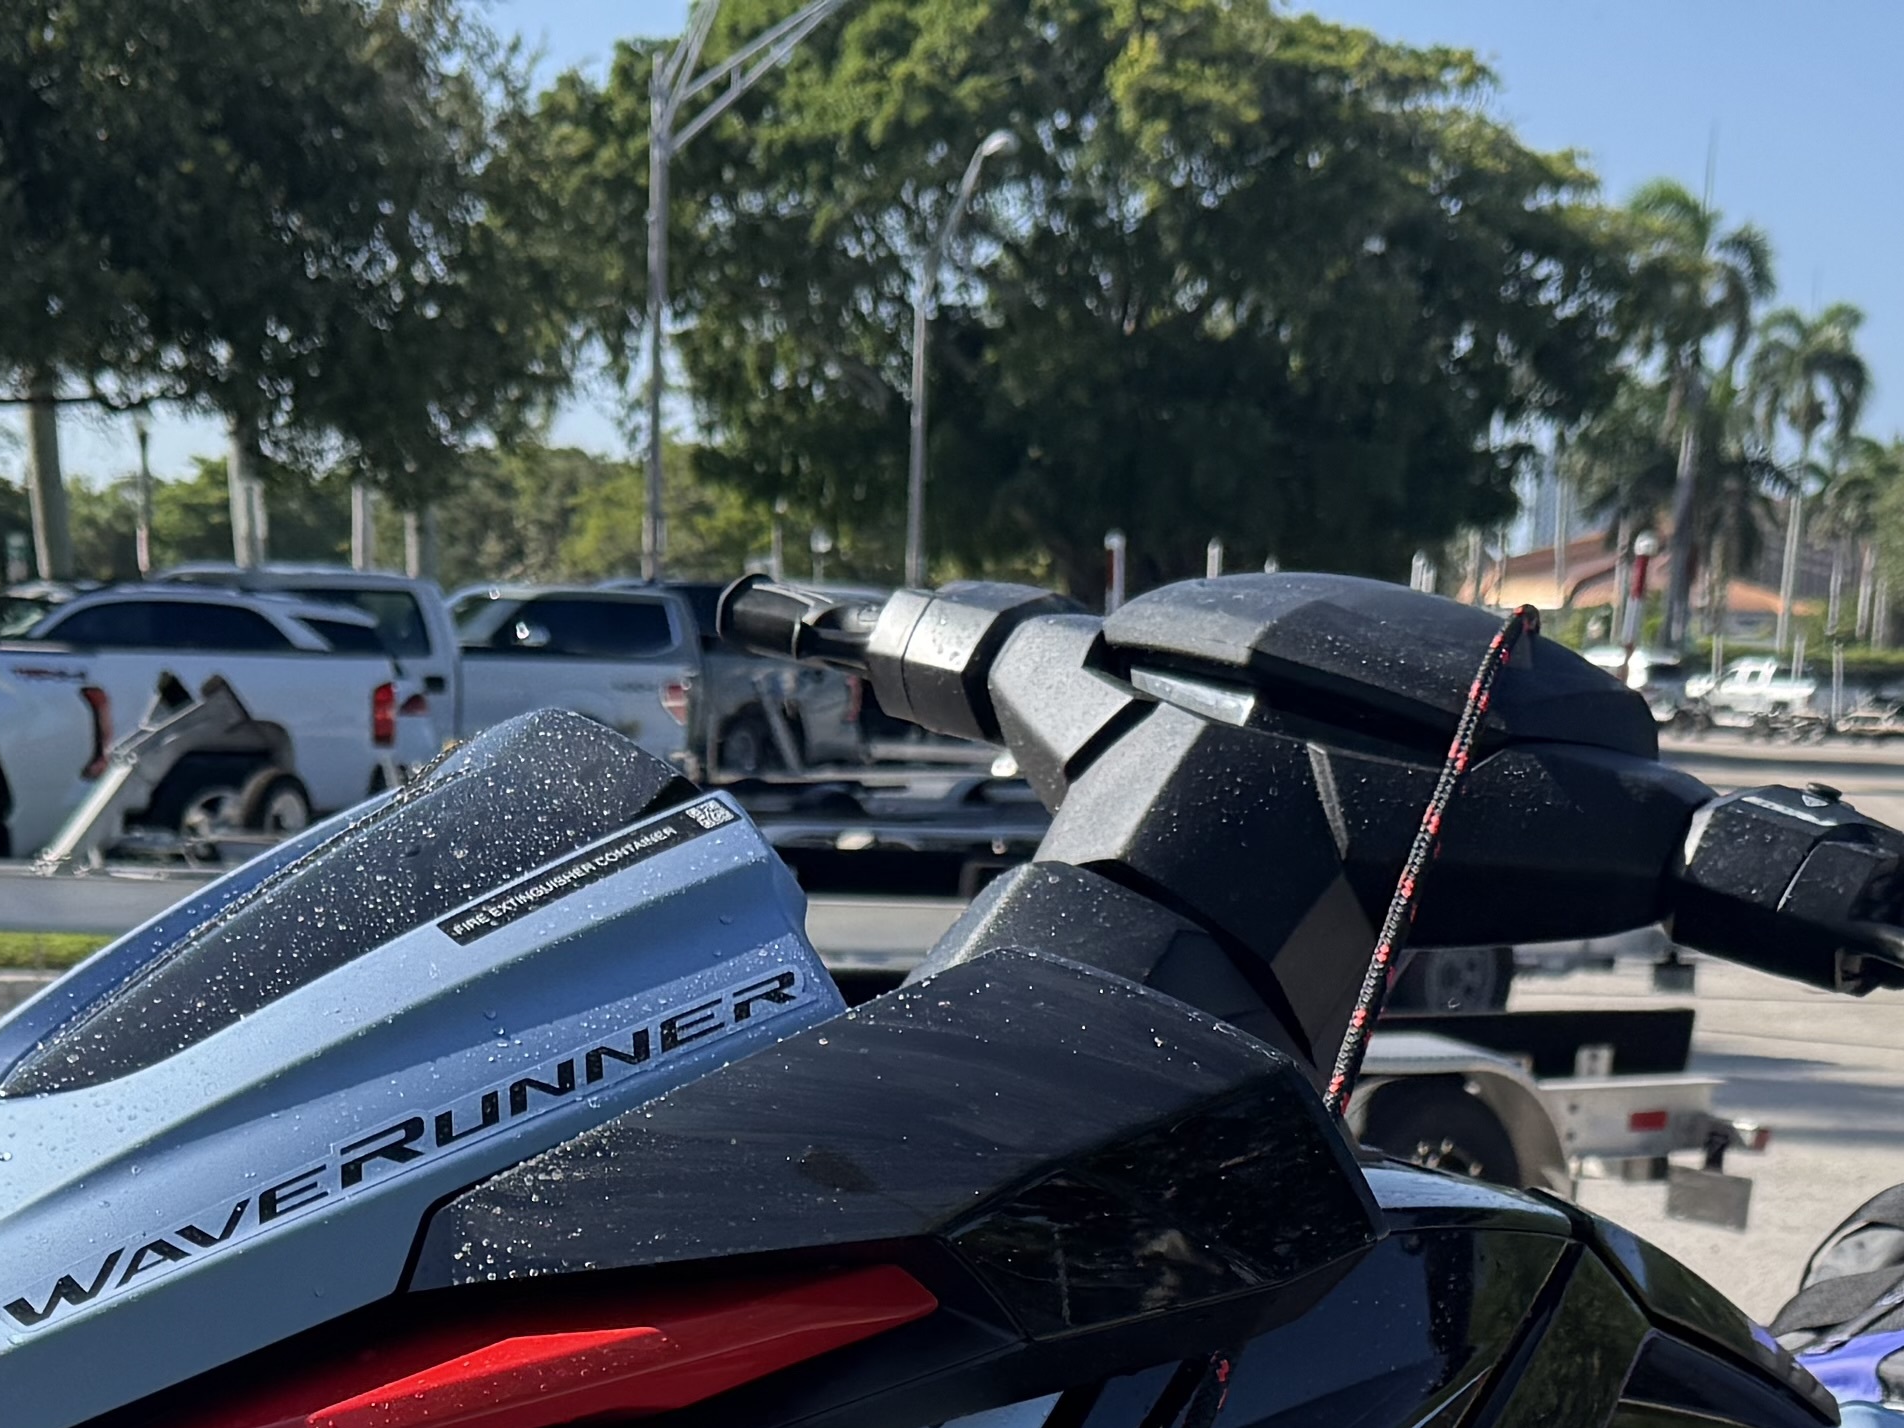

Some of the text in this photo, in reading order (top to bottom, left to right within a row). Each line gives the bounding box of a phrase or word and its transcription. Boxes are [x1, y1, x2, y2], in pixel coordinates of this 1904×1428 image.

[453, 826, 678, 936] FIRE EXTINGUISHER CONTAINER
[1, 969, 798, 1326] WAVERUNNER
